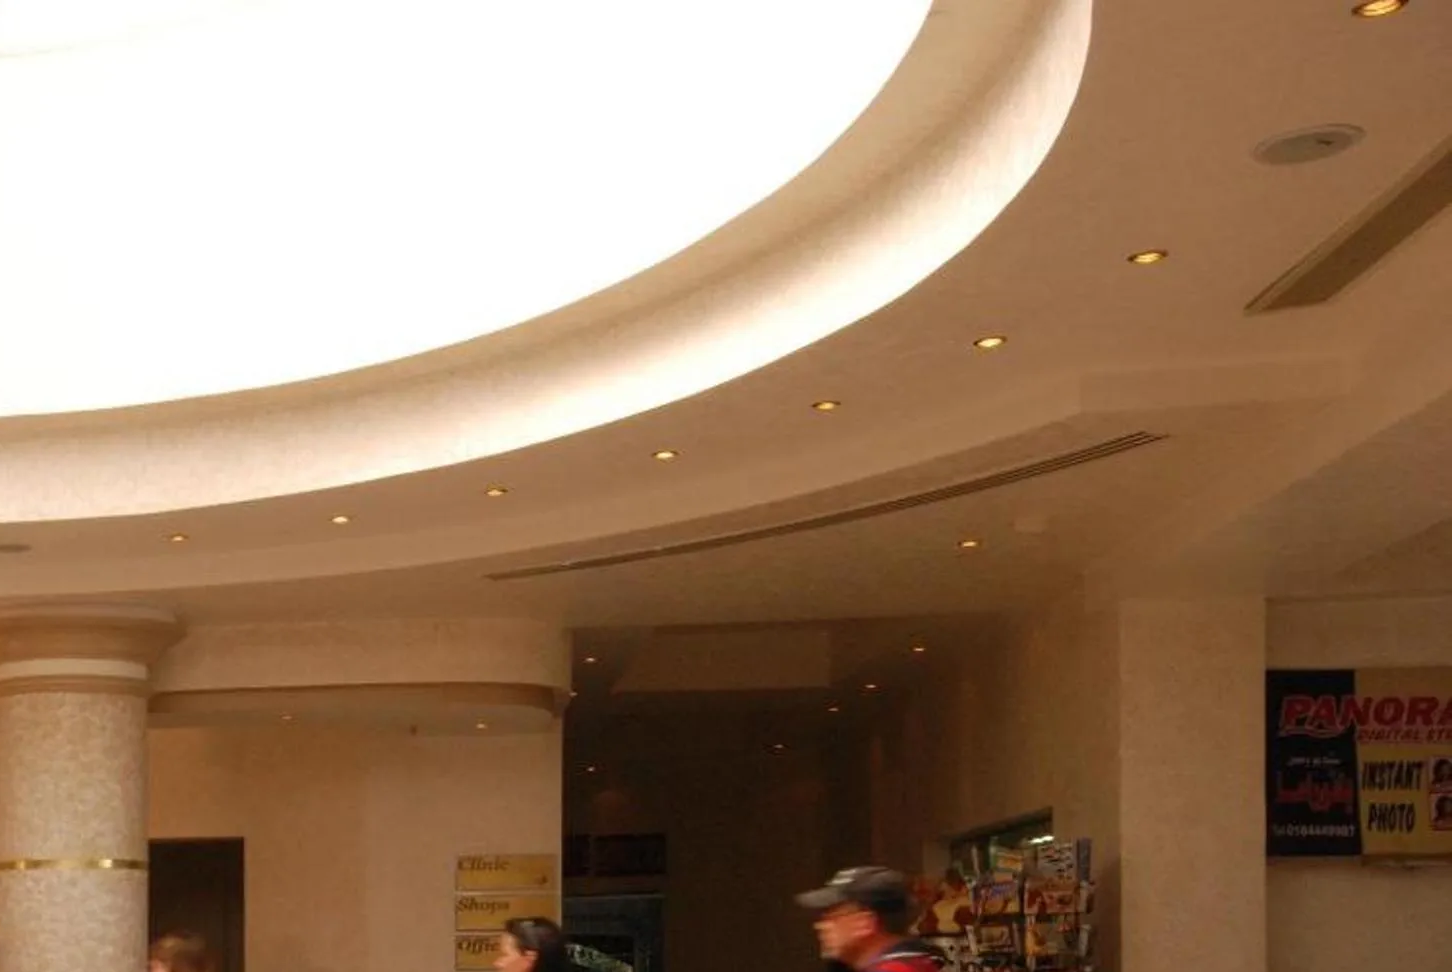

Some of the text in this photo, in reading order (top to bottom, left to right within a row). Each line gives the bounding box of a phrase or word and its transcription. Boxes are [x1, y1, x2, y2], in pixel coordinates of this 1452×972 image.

[1362, 761, 1423, 790] INSTANT
[1368, 803, 1415, 833] PHOTO
[457, 856, 510, 871] Clinic
[457, 896, 511, 913] Shops
